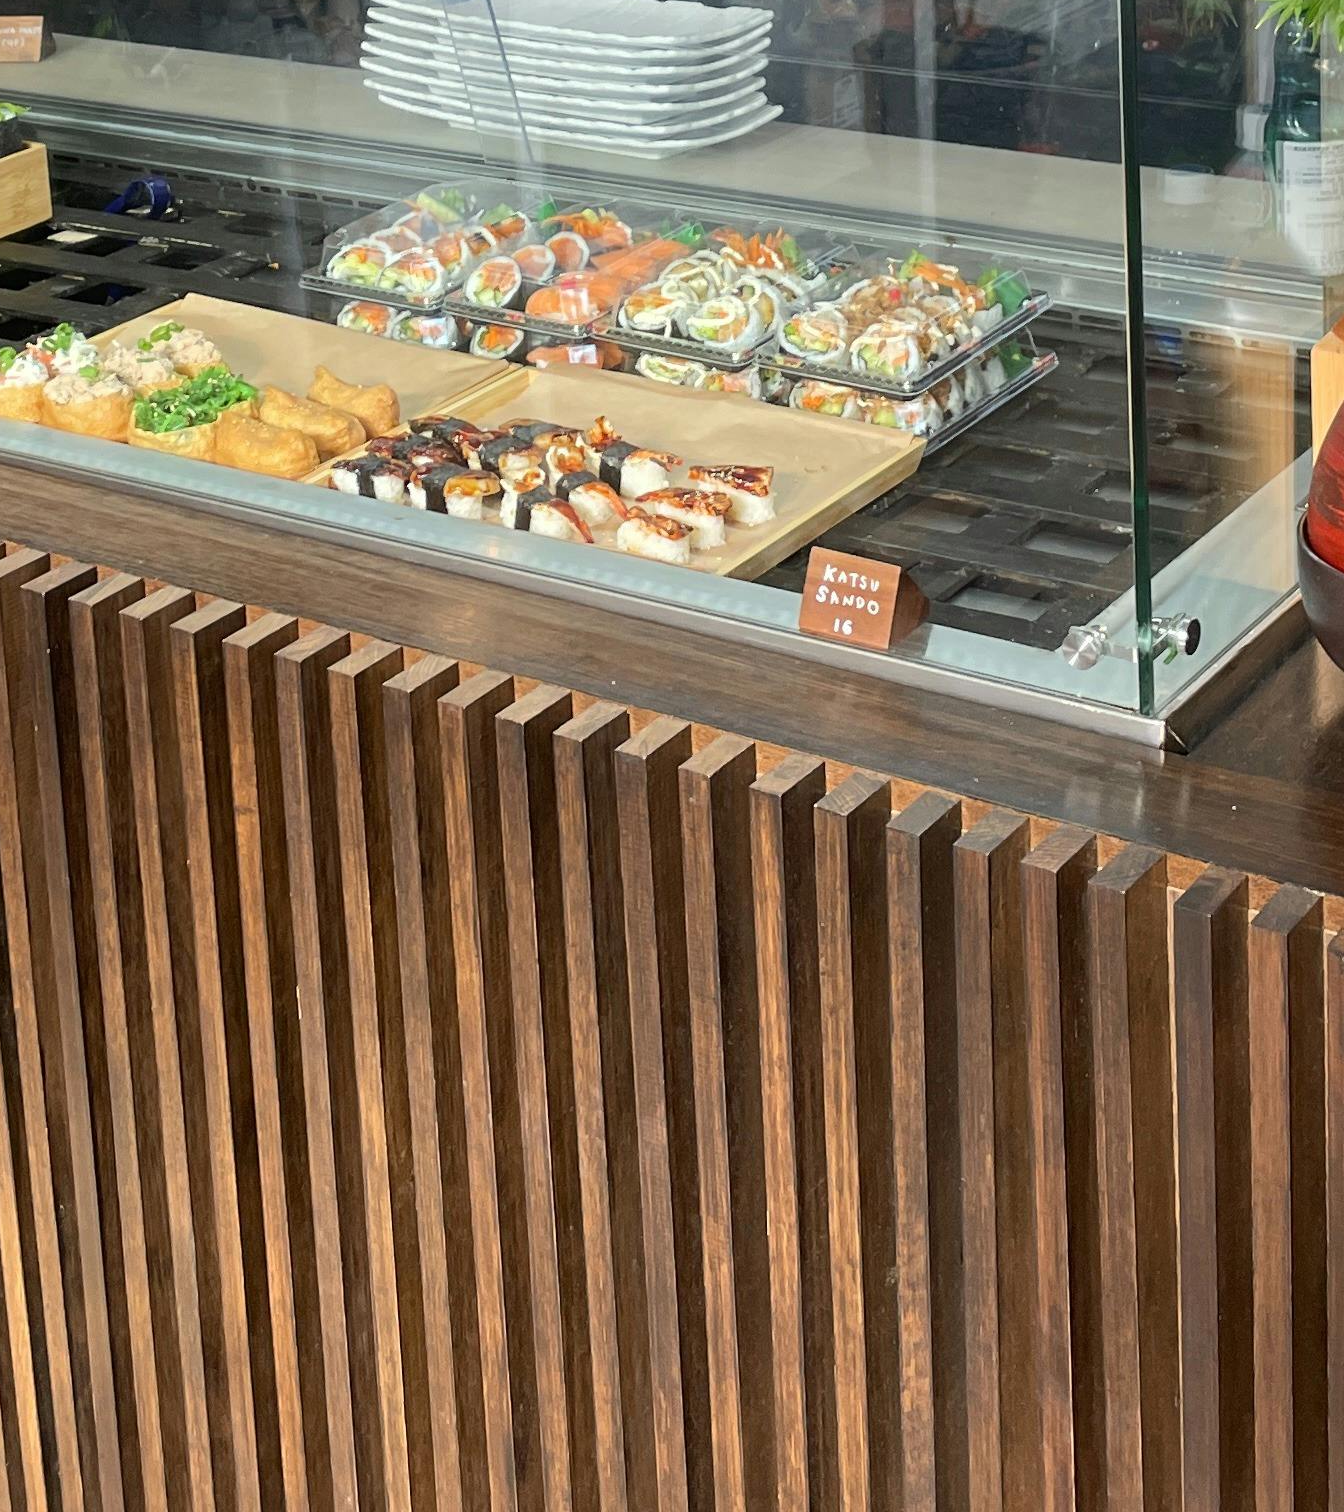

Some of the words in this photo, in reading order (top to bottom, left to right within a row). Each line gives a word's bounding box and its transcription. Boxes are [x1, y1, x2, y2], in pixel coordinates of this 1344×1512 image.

[823, 563, 880, 592] KATSU
[815, 584, 880, 616] SANDO
[833, 617, 853, 635] 16
